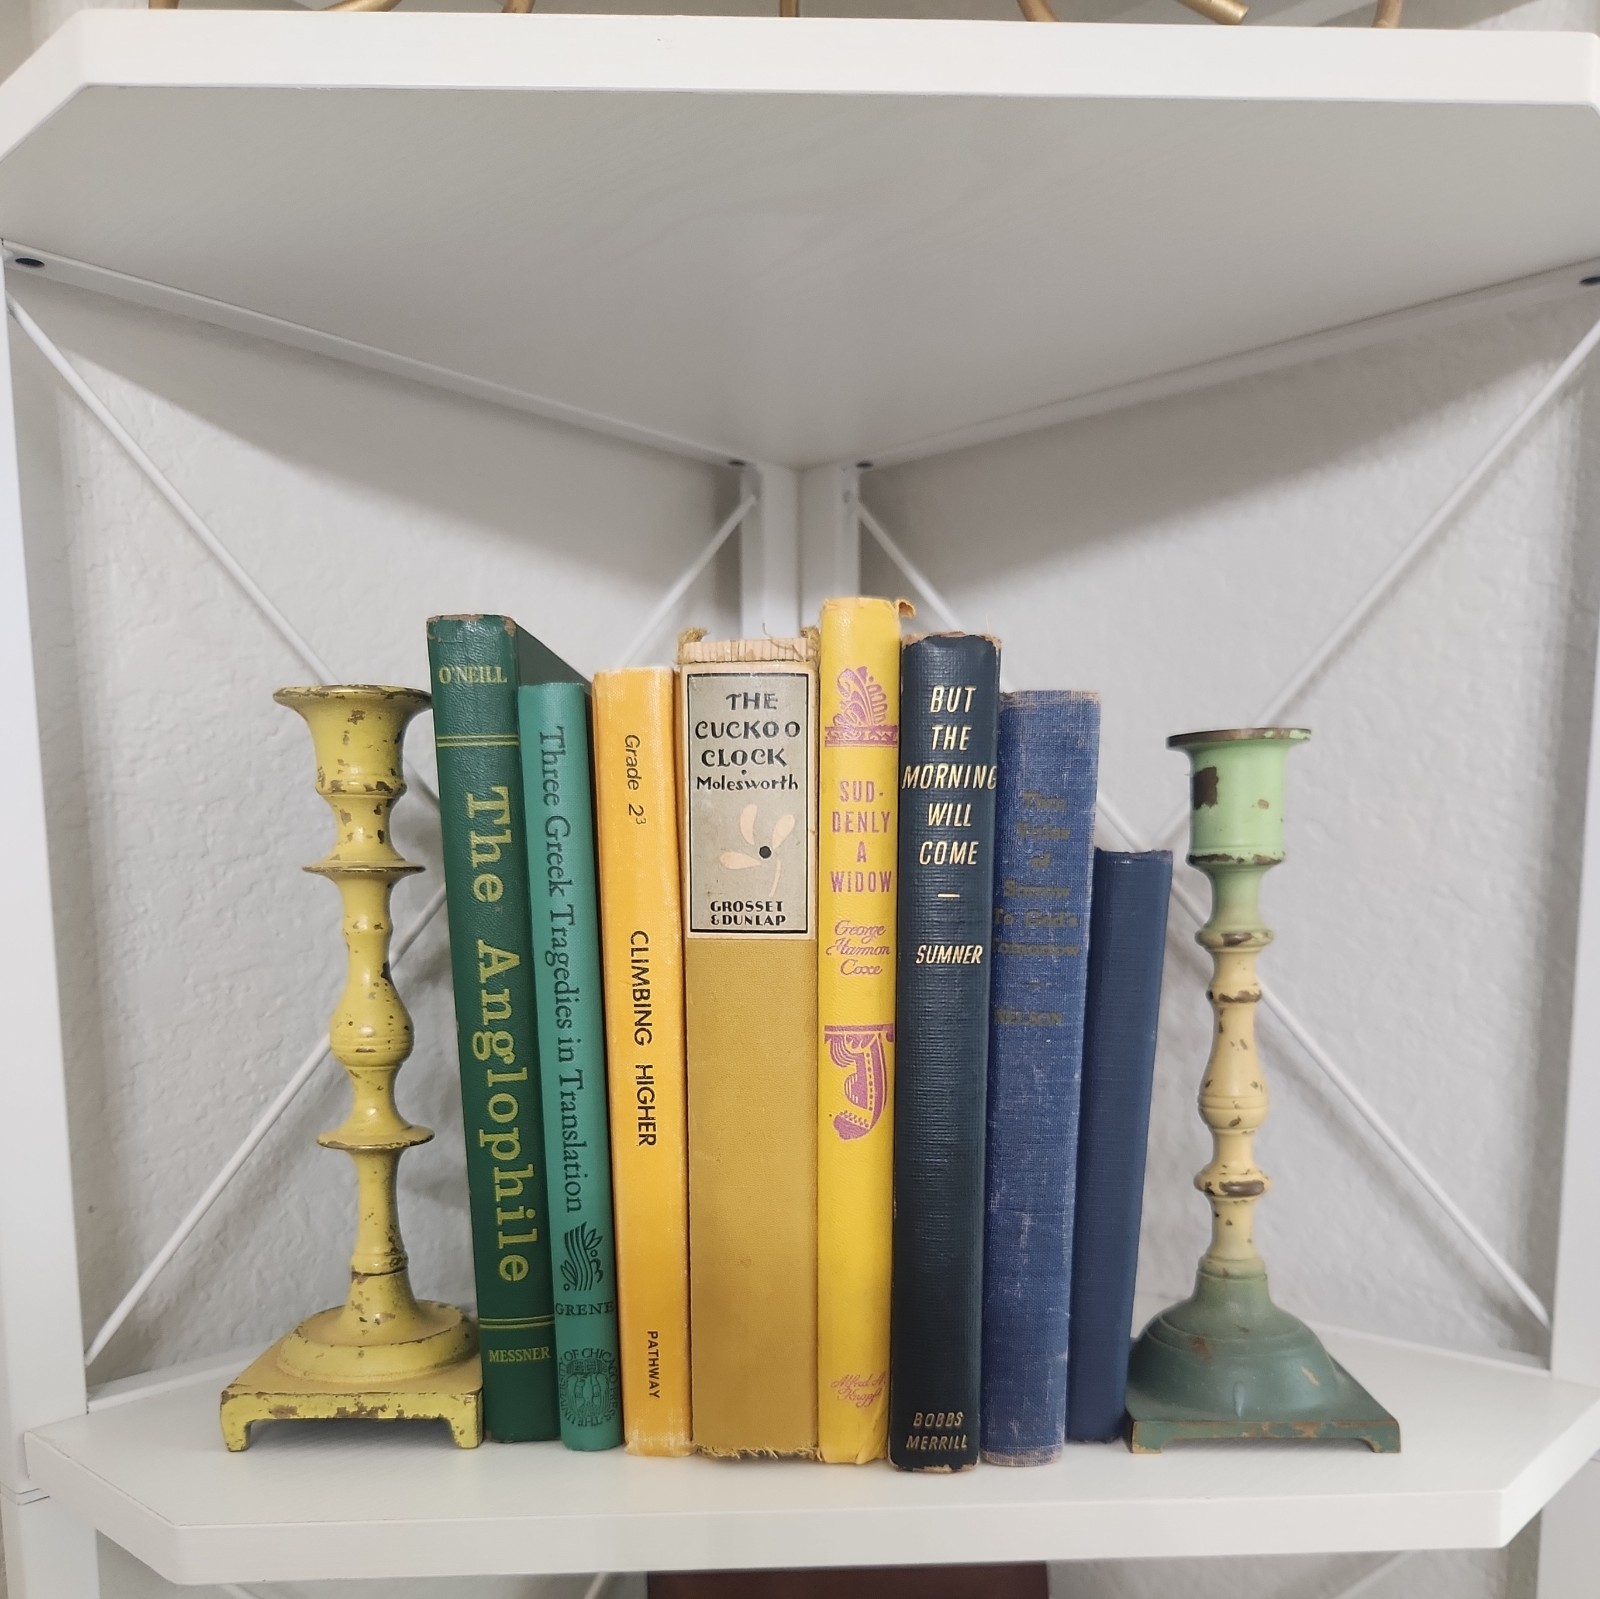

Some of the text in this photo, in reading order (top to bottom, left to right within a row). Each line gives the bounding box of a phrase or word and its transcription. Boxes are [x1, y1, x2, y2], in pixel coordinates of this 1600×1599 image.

[726, 692, 778, 711] THE
[930, 685, 977, 713] BUT
[695, 720, 801, 740] CUCKOO
[931, 725, 972, 751] THE
[624, 734, 642, 791] Grade
[701, 748, 787, 767] CLOCK
[696, 774, 799, 791] Molesworth
[901, 763, 997, 790] MORNING
[832, 811, 890, 833] DENLY
[928, 803, 972, 827] WILL
[856, 841, 867, 863] A
[919, 841, 978, 865] COME
[830, 871, 892, 893] WIDOW
[710, 900, 784, 913] GROSSET
[834, 919, 887, 944] George
[916, 945, 983, 964] SUMNER
[539, 726, 588, 1214] Three Greek Tragedies in Translation
[466, 786, 539, 1283] The Anglophile
[630, 930, 657, 1147] CLIMBING HIGHER
[555, 1301, 615, 1316] GRENE
[489, 1346, 551, 1363] MESSNER
[563, 1349, 579, 1361] OF
[647, 1329, 661, 1400] PATHWAY
[913, 1411, 964, 1427] BOBBS
[906, 1434, 968, 1450] MERRILL
